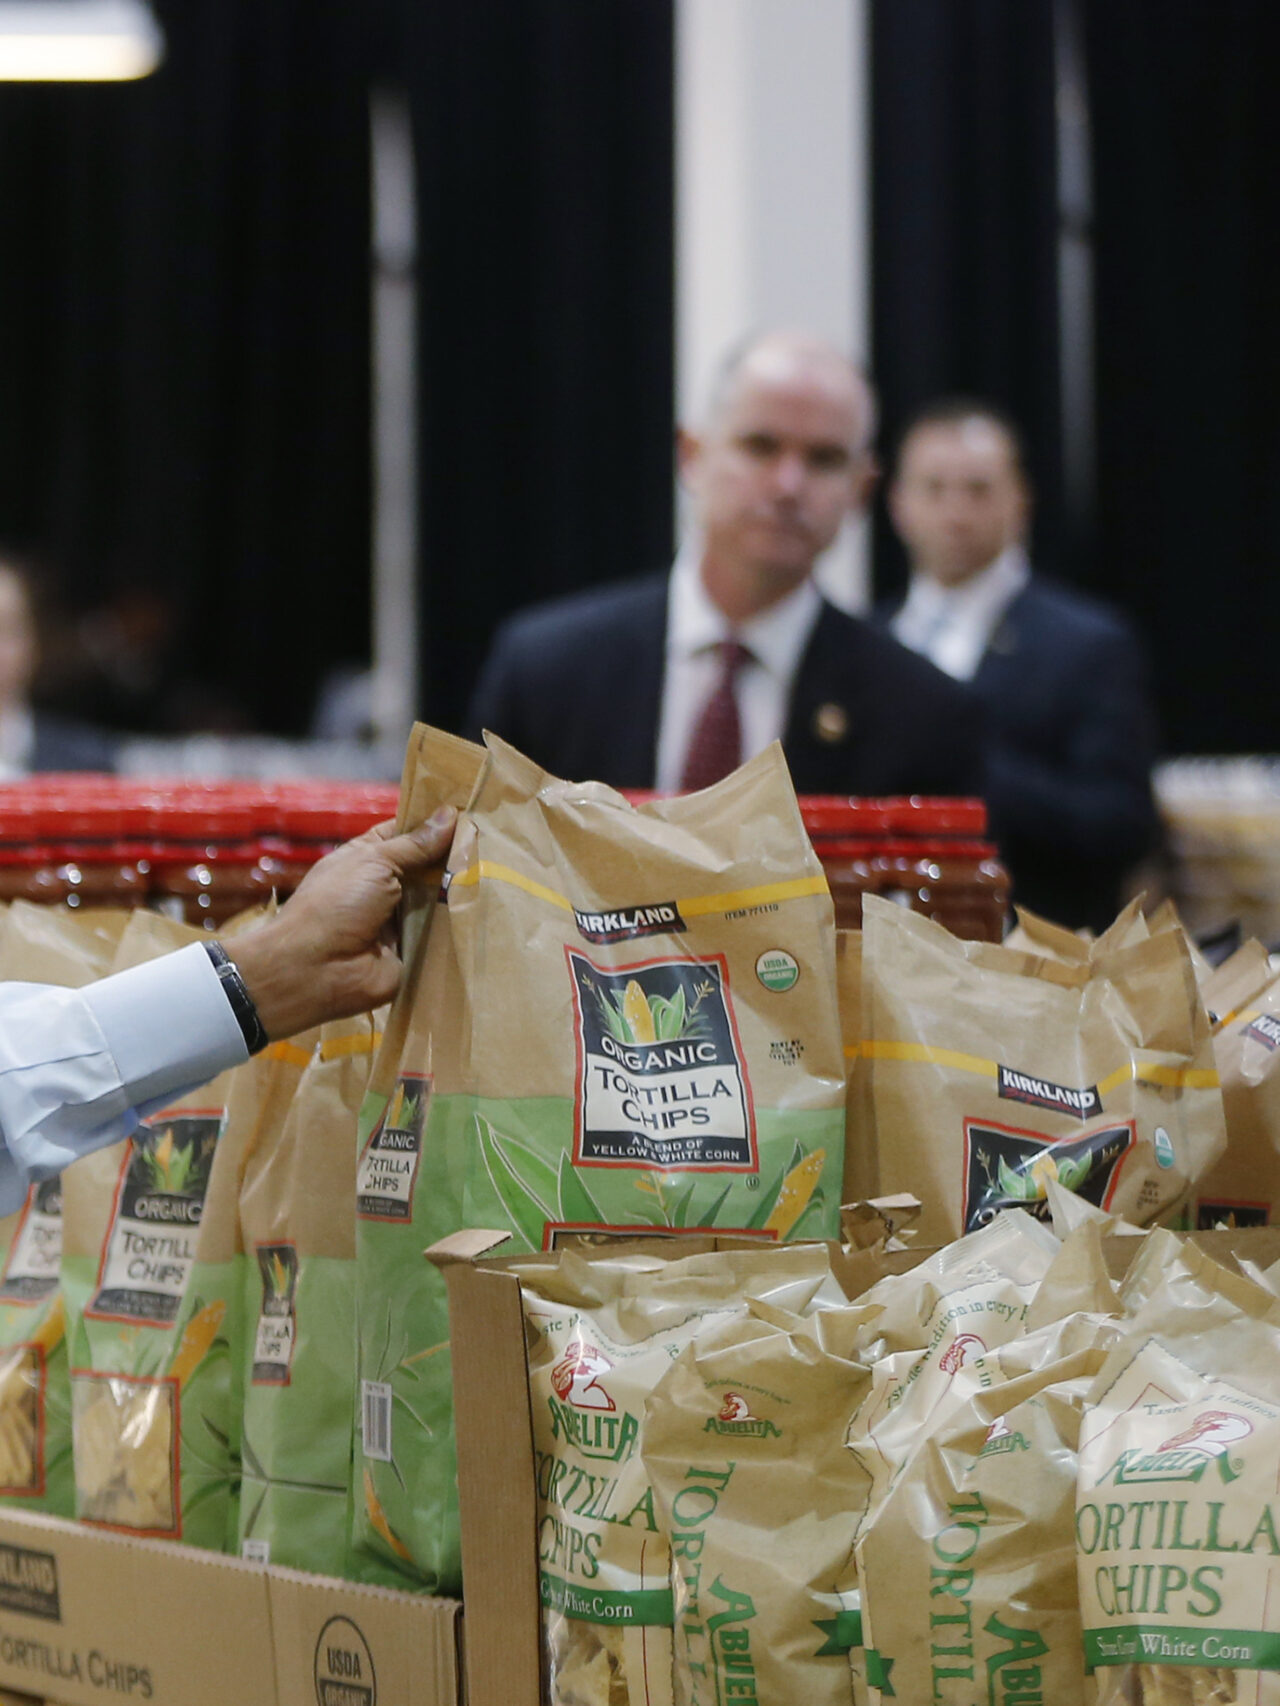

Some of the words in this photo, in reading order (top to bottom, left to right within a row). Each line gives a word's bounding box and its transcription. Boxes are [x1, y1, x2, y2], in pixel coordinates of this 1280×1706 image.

[763, 958, 789, 968] USDA
[601, 1036, 718, 1071] ORGANIC
[594, 1065, 733, 1105] TORTILLA
[1002, 1068, 1096, 1109] KIRKLAND
[622, 1099, 711, 1130] CHIPS
[379, 1133, 415, 1149] GANIC
[592, 1144, 648, 1157] YELLOW
[659, 1150, 702, 1163] WHITE
[705, 1150, 740, 1161] CORN
[631, 1136, 640, 1146] A
[686, 1138, 704, 1150] OF
[122, 1230, 194, 1260] TORTILL
[127, 1257, 186, 1285] CHIPS
[703, 1417, 783, 1438] ABUELITA
[1075, 1500, 1280, 1556] ORTILLA
[539, 1514, 602, 1579] CHIPS
[672, 1461, 736, 1706] TORTILL
[929, 1491, 989, 1706] TORTIL
[1095, 1564, 1224, 1618] CHIPS
[592, 1597, 634, 1618] Corn
[1139, 1633, 1197, 1657] White
[1202, 1636, 1251, 1660] Corn
[87, 1650, 154, 1700] CHIPS
[326, 1646, 362, 1680] USDA
